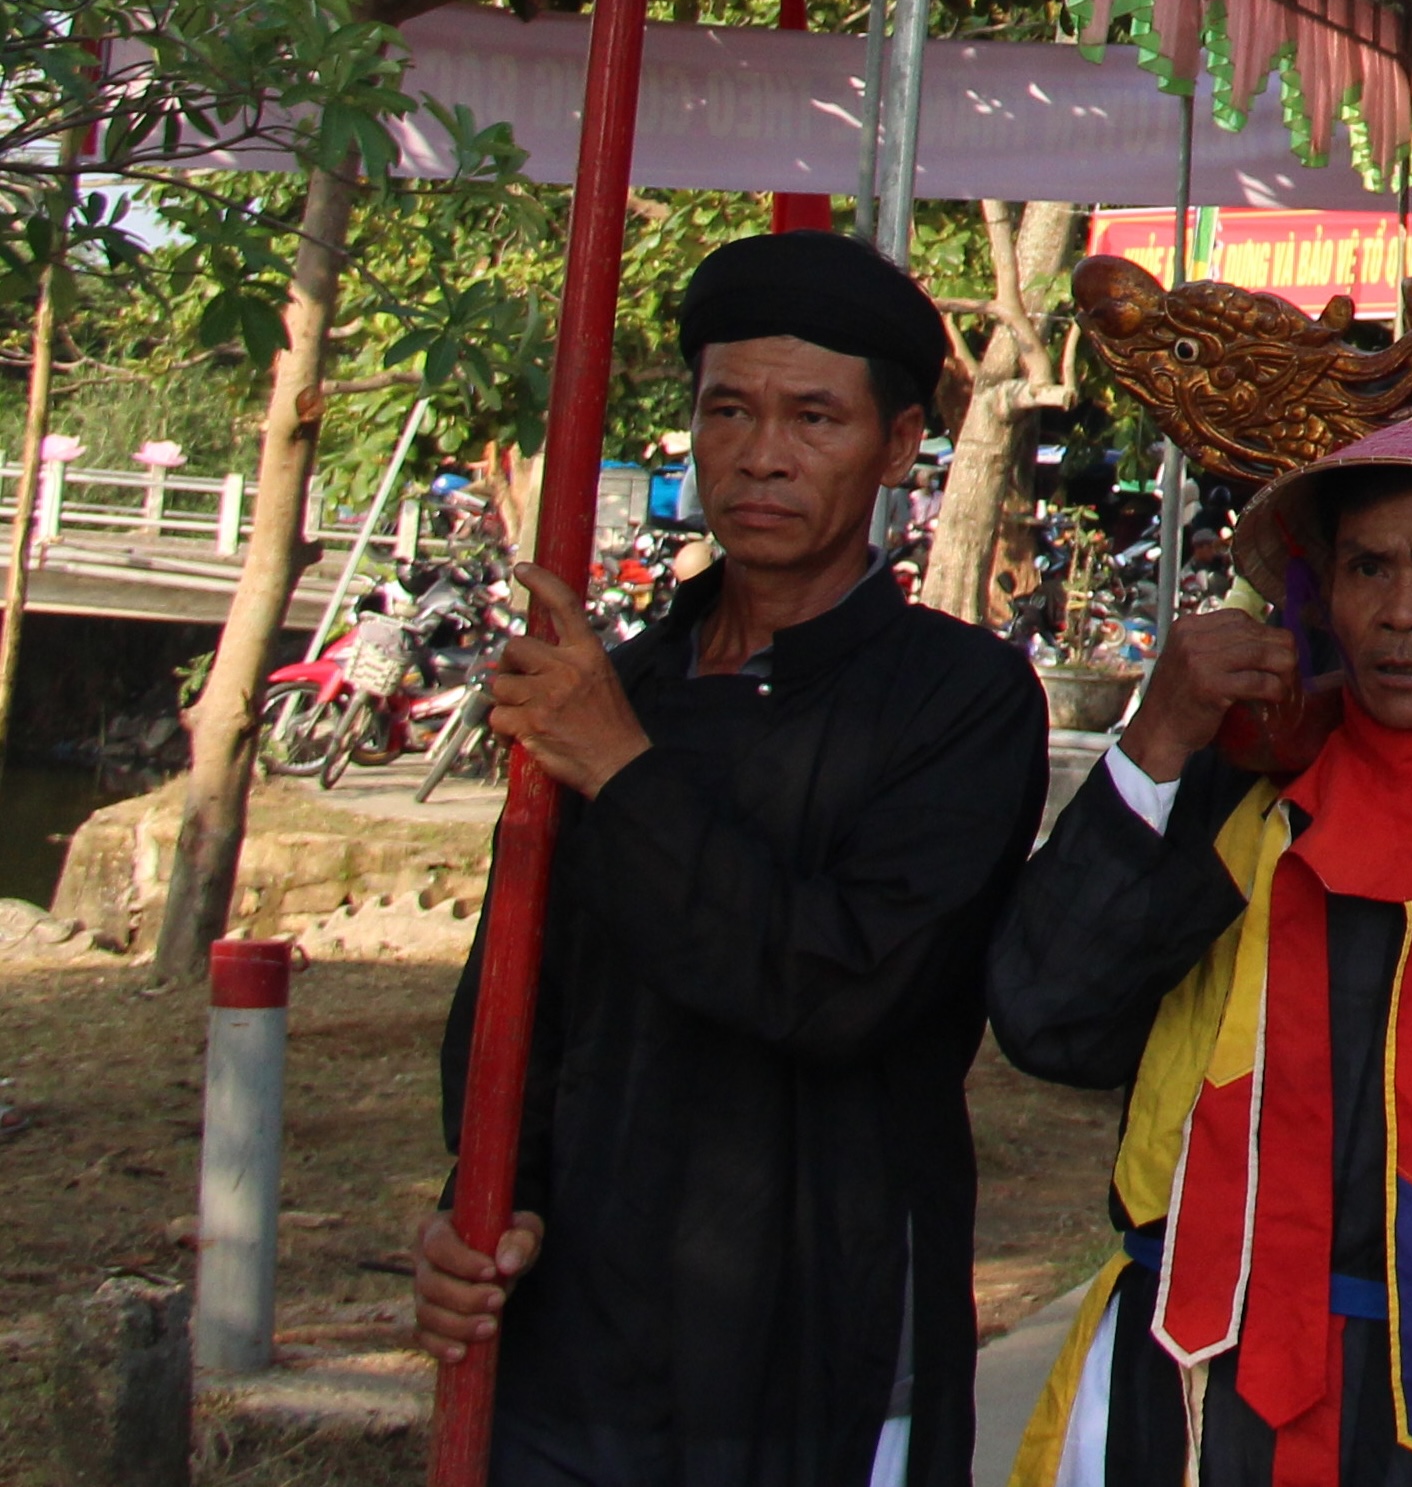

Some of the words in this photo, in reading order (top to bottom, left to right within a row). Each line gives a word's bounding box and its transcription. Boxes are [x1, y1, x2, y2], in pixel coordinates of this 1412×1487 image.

[1272, 231, 1296, 287] VÀ
[1296, 224, 1334, 287] BẢO
[1335, 228, 1360, 295] VỆ
[1360, 218, 1387, 285] TỔ
